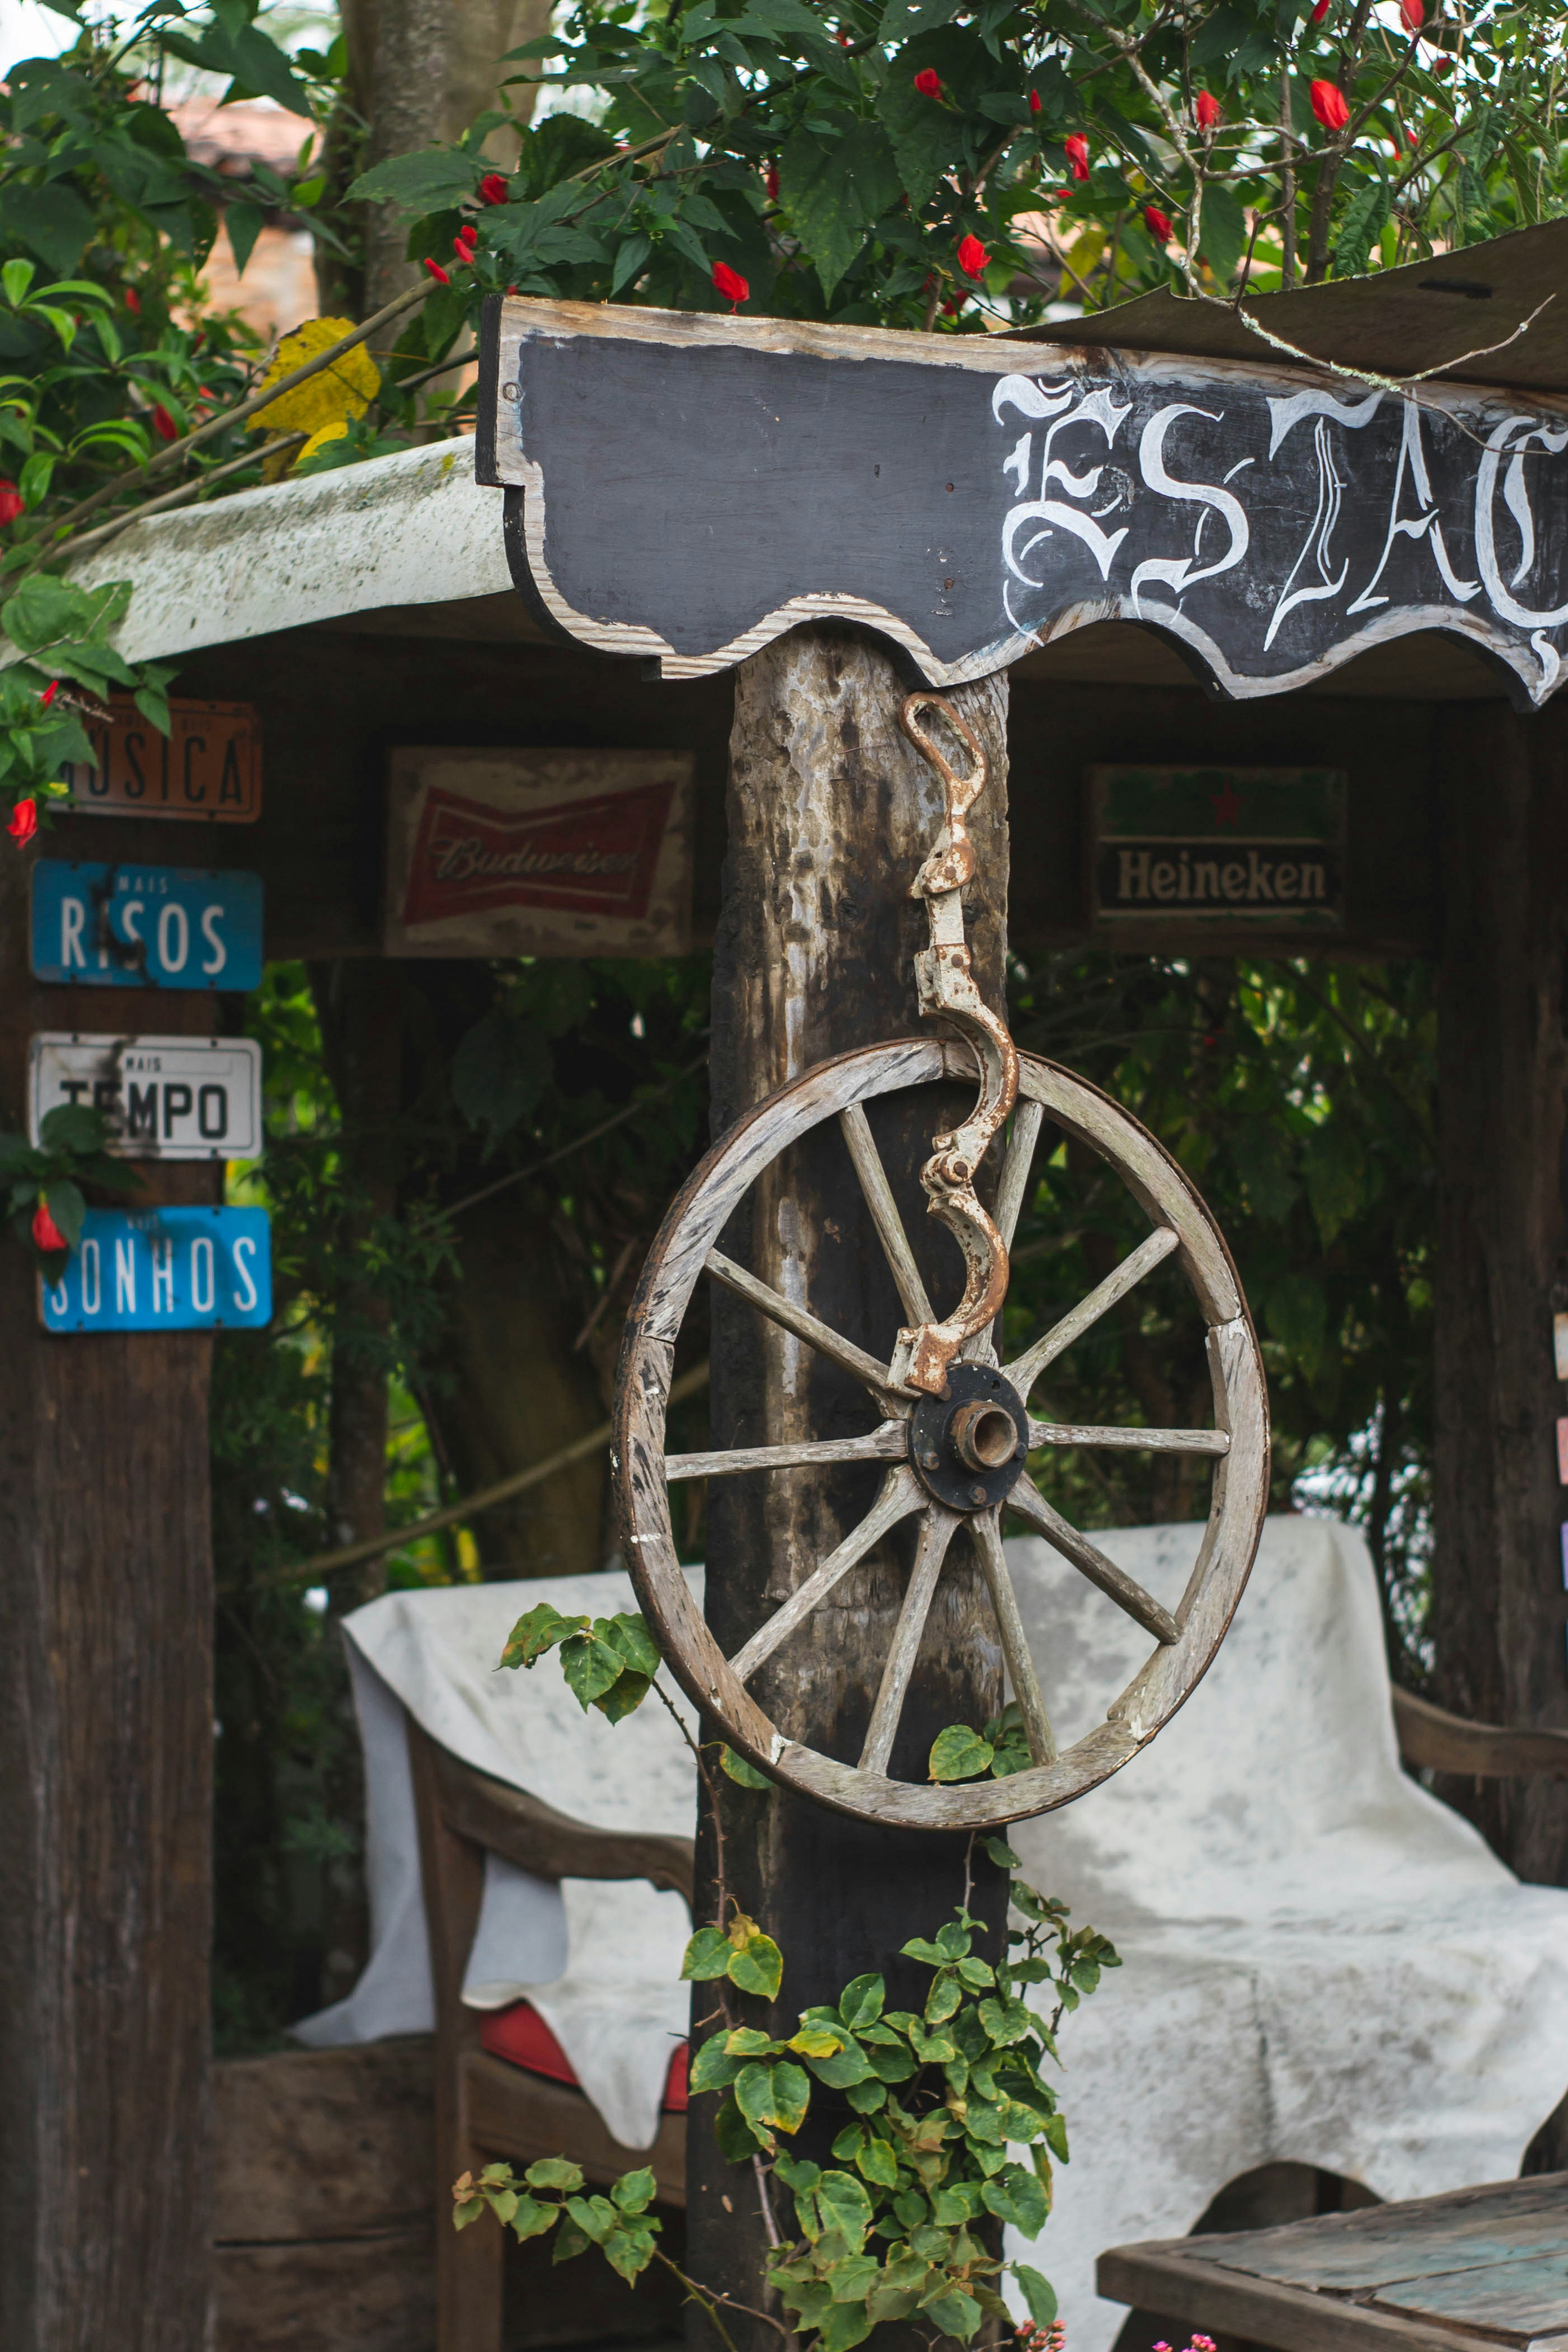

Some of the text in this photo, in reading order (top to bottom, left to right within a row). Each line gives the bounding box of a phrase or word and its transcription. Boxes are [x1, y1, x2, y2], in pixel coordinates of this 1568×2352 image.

[60, 724, 242, 804] ÚSICA
[428, 837, 639, 880] Budweiser
[1118, 850, 1326, 900] Heineken
[118, 875, 168, 894] MAIS
[126, 1057, 162, 1072] MAIS
